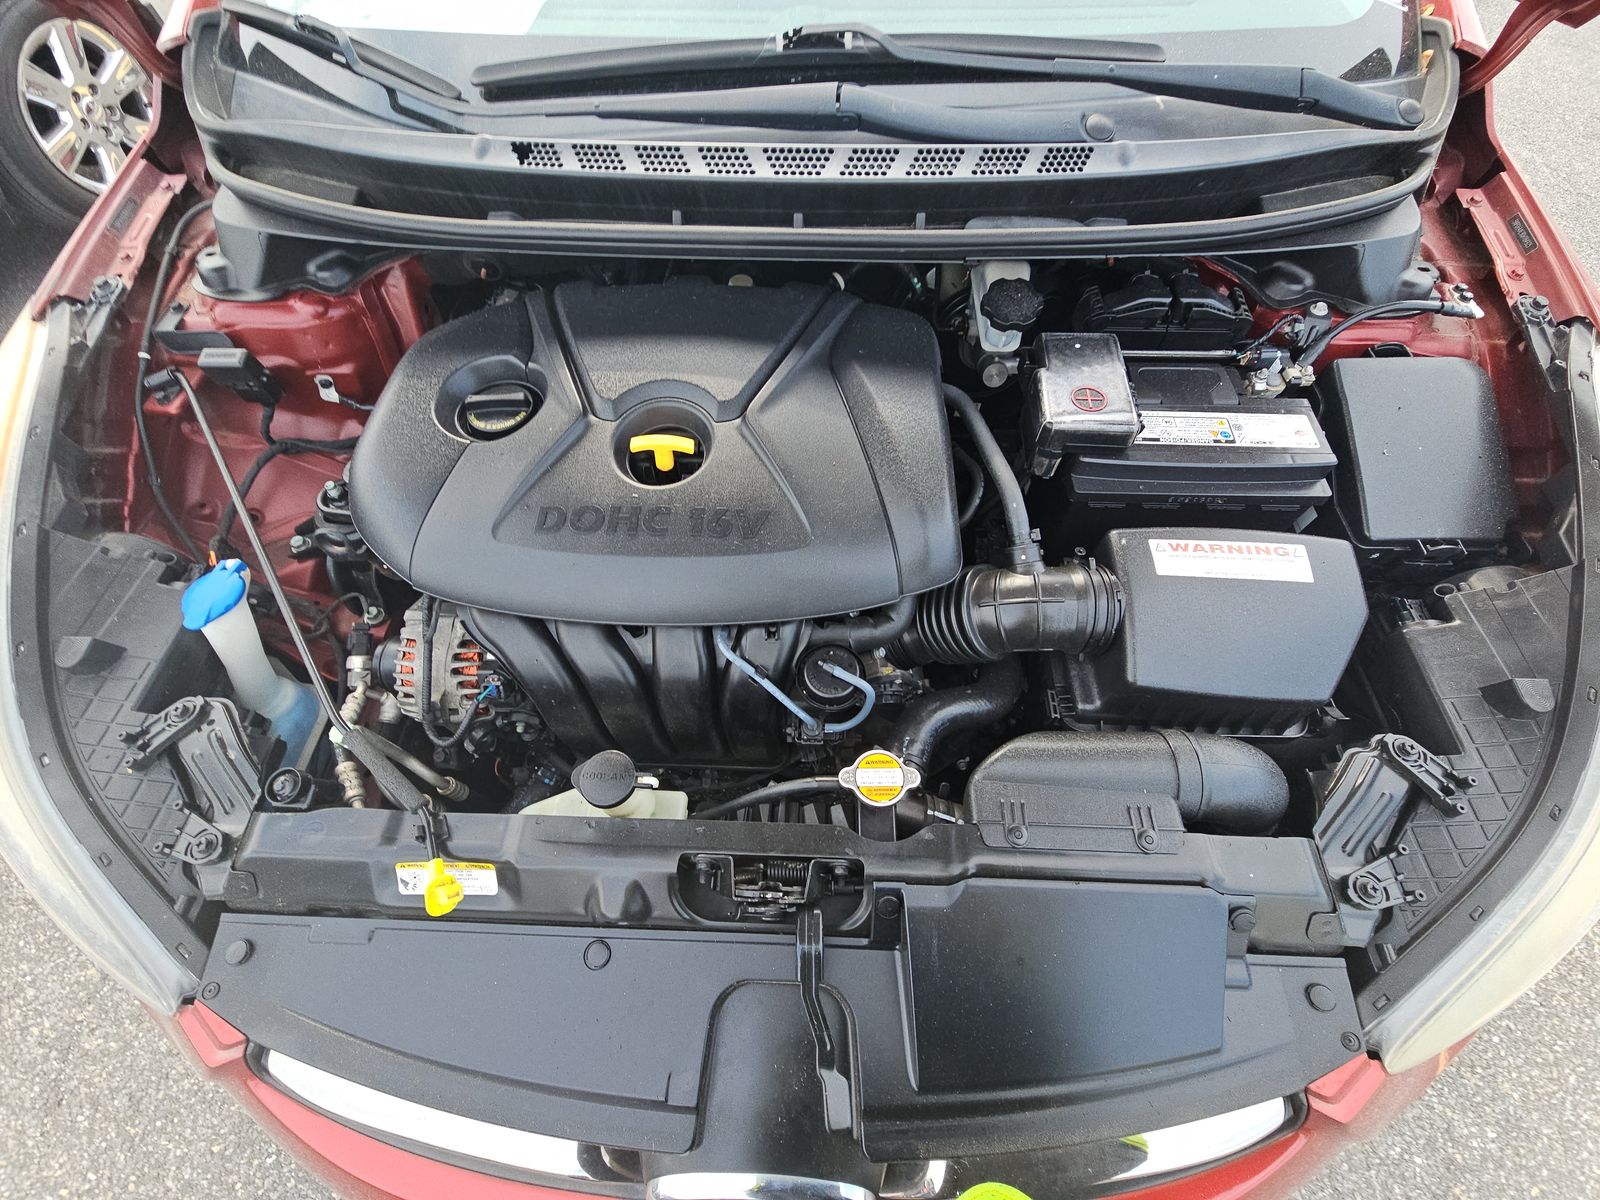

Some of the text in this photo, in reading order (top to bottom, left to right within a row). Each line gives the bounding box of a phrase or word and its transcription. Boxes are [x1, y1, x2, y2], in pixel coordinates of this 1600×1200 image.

[534, 504, 773, 539] DOHC 16V
[1168, 543, 1290, 557] WARNING
